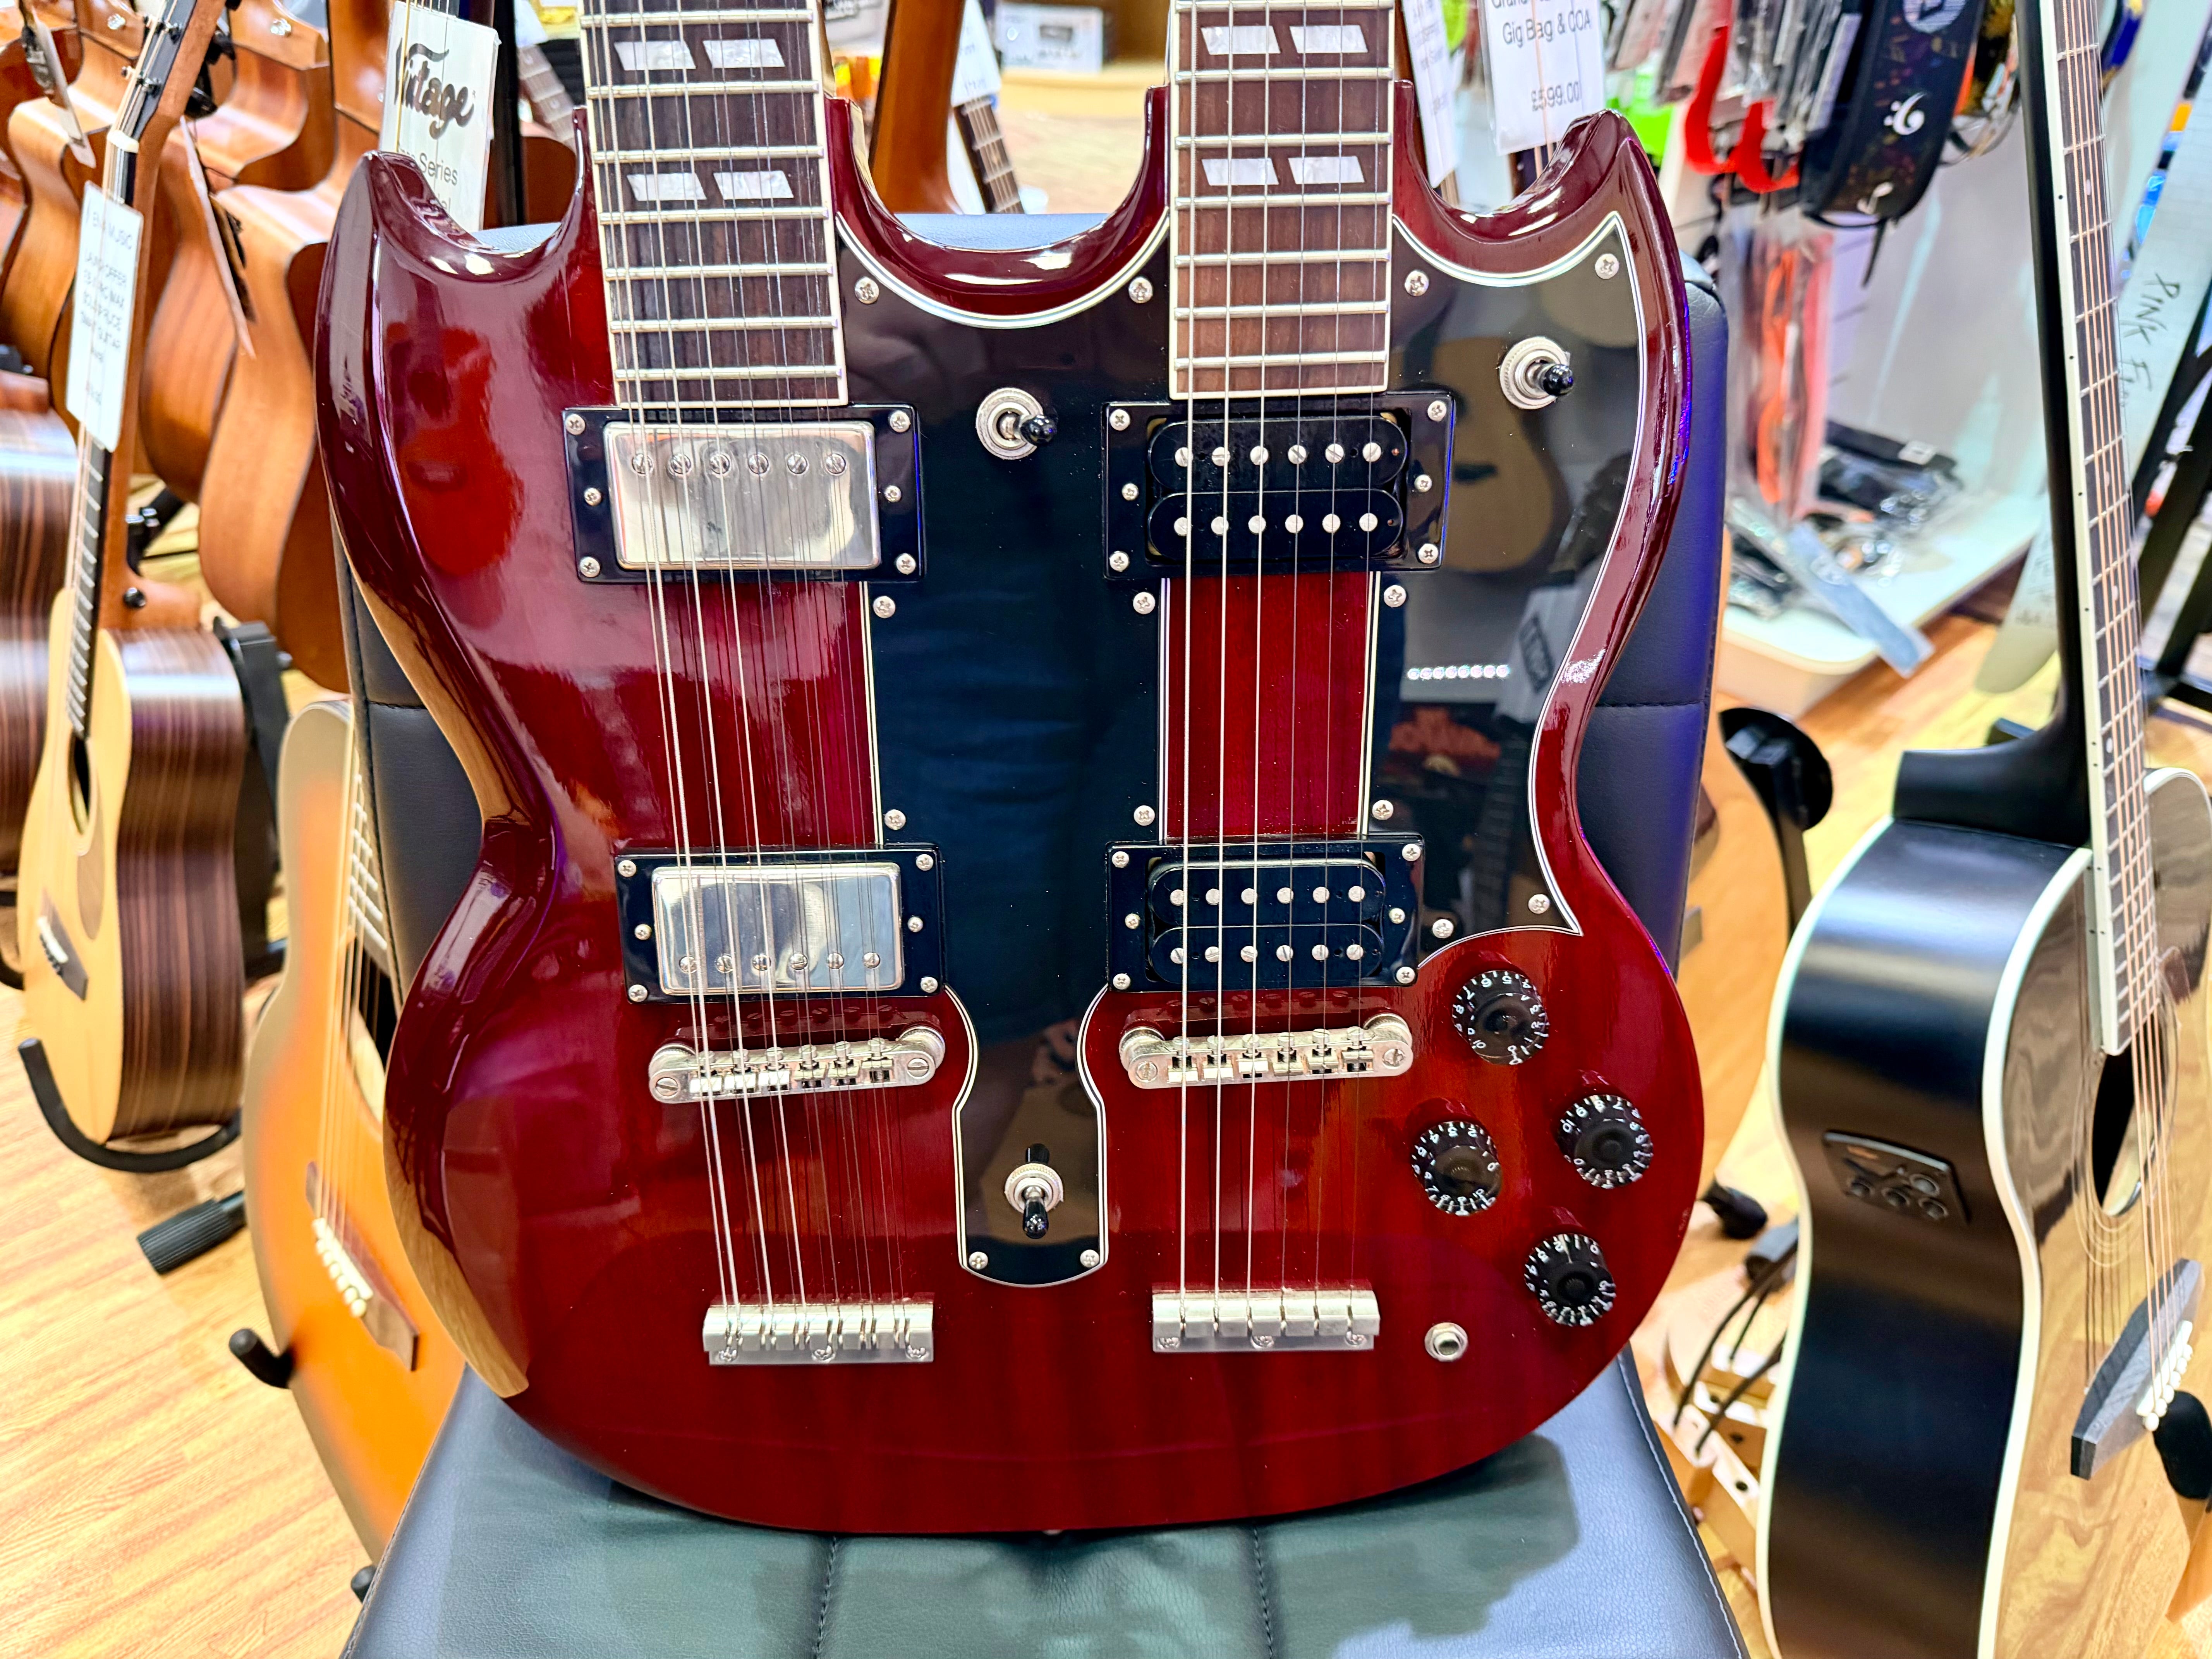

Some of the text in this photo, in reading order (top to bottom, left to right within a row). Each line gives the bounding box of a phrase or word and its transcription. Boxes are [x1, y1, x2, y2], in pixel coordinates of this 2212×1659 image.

[1503, 22, 1523, 48] Gig
[1525, 19, 1553, 42] Bag
[1557, 13, 1565, 34] &
[1531, 81, 1579, 111] £599.00
[419, 152, 458, 186] Series
